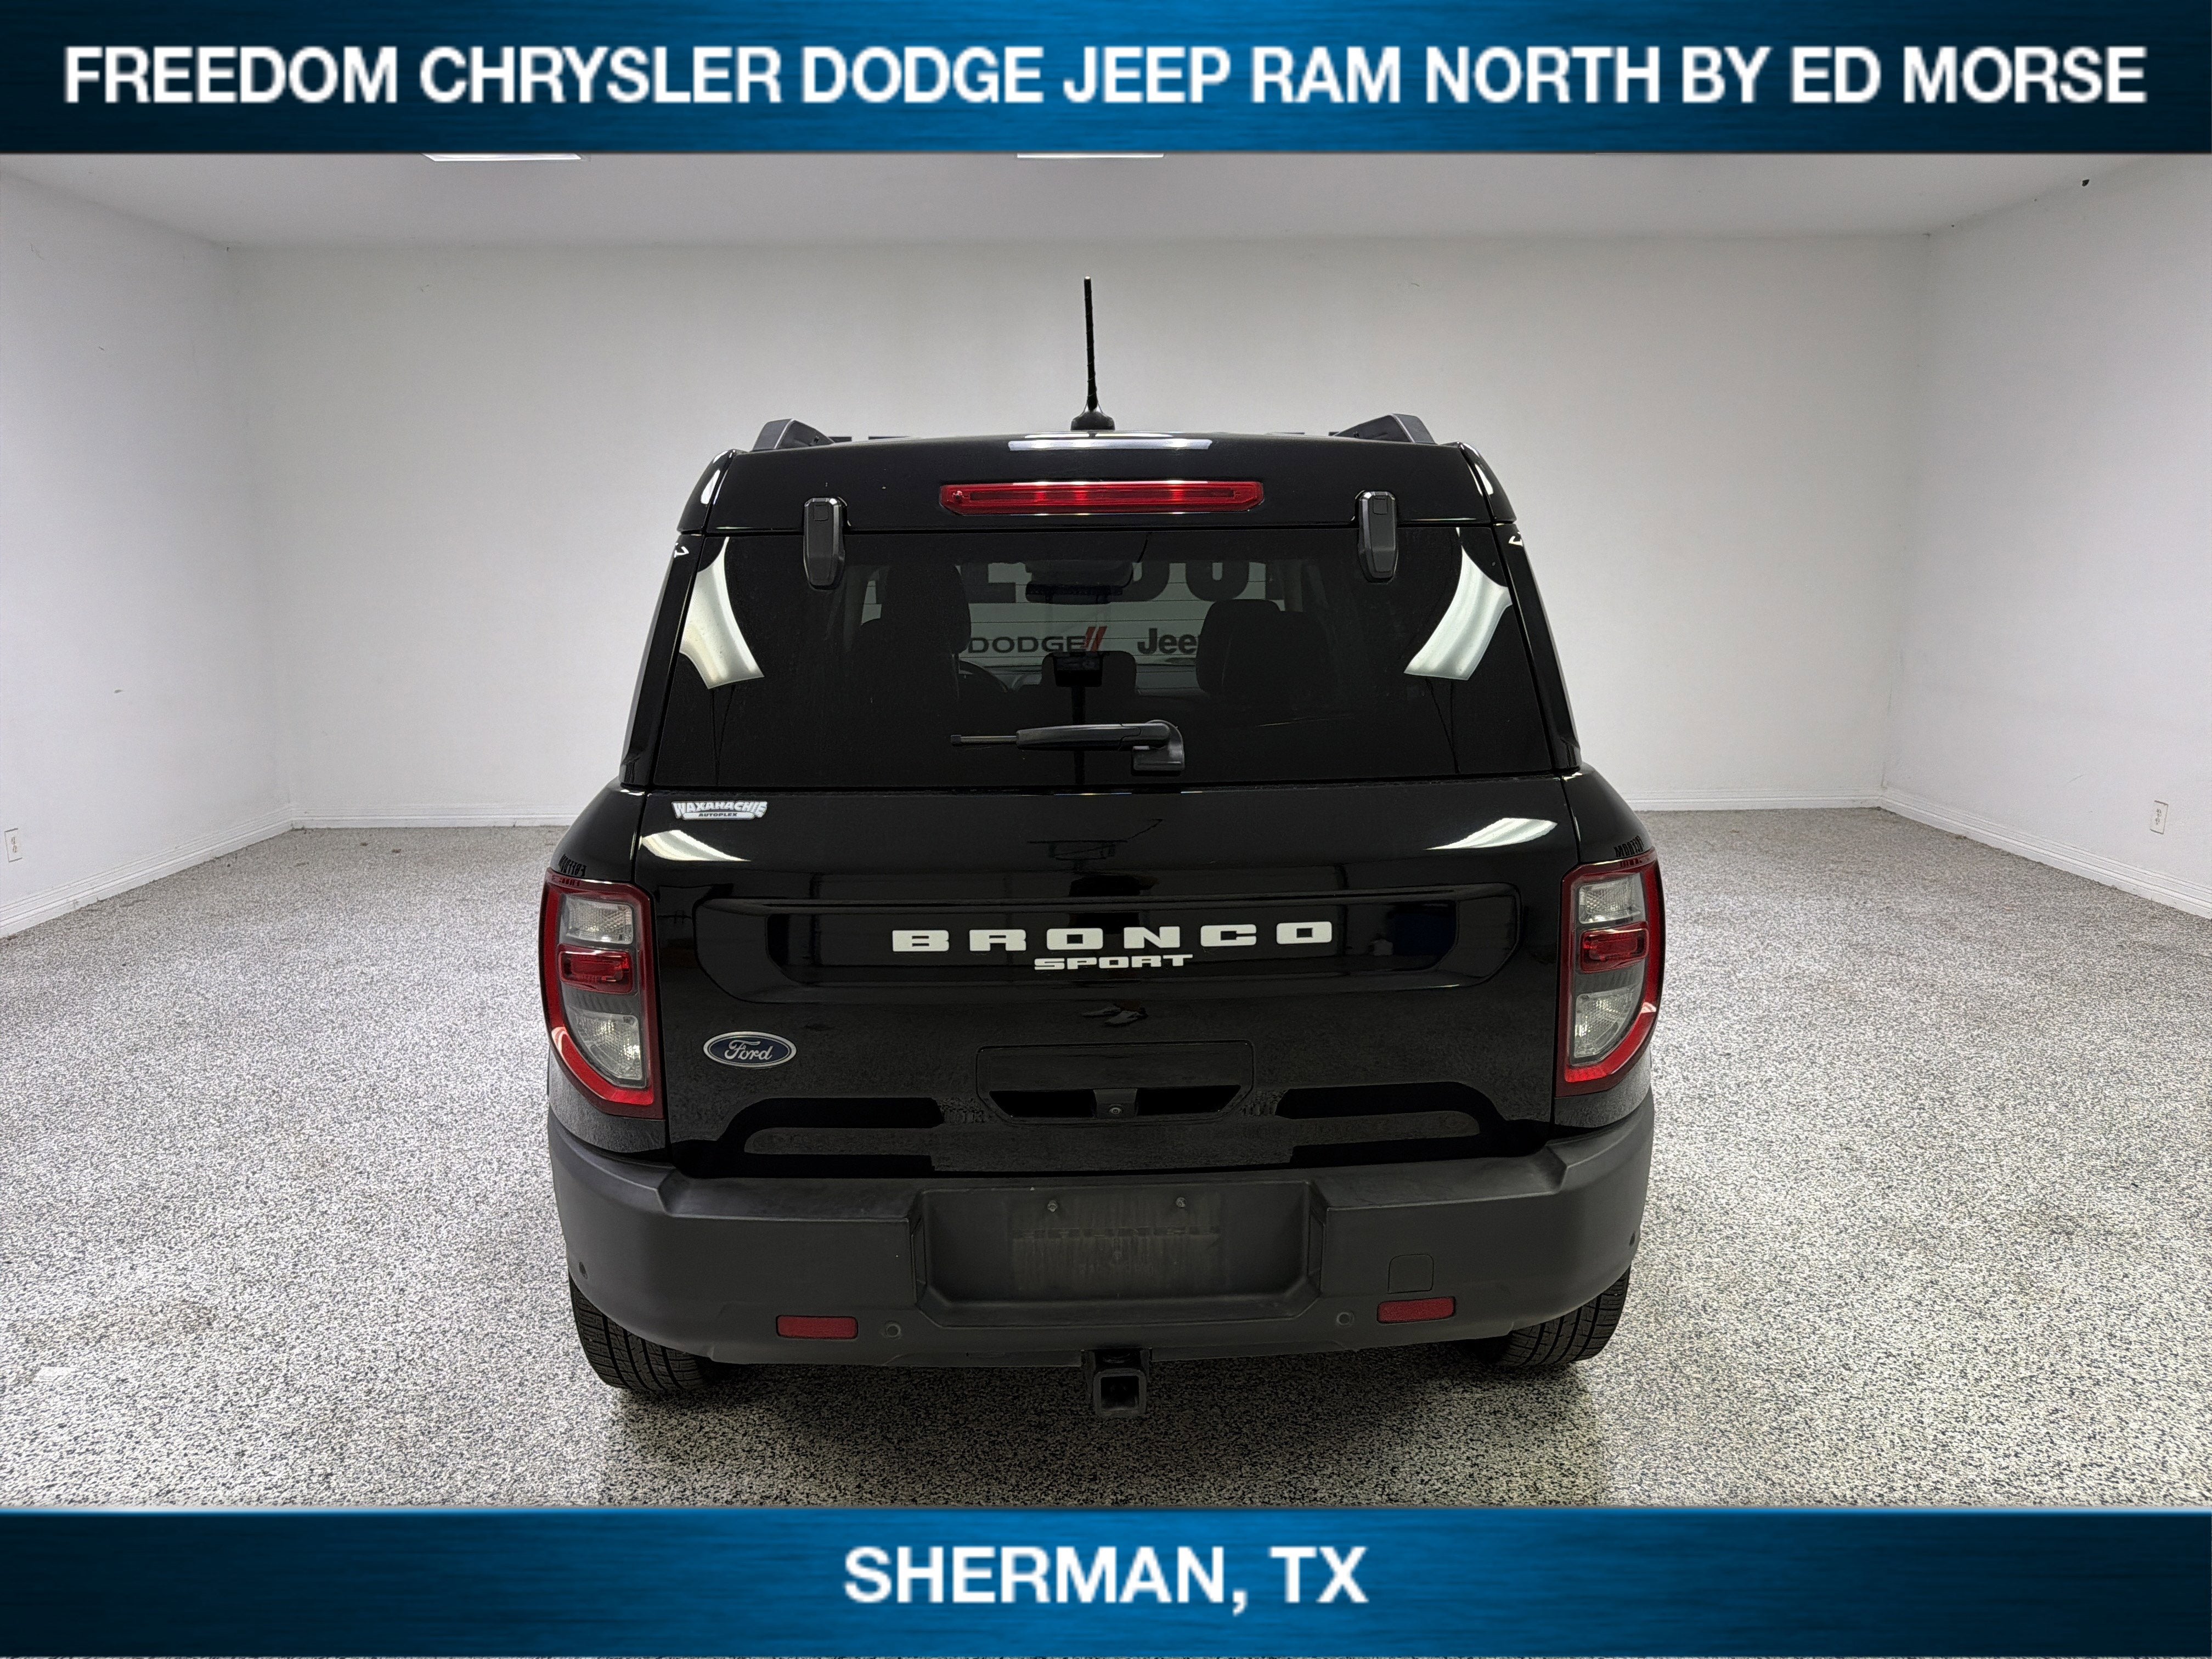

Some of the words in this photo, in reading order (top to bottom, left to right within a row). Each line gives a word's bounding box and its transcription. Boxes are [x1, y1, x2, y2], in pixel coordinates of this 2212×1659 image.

[968, 635, 1086, 653] DODGE
[1137, 628, 1200, 654] Jee
[672, 801, 768, 818] WAXAHACHIE
[892, 921, 1332, 952] BRONCO
[1034, 953, 1193, 970] SPORT
[724, 1039, 773, 1060] Ford
